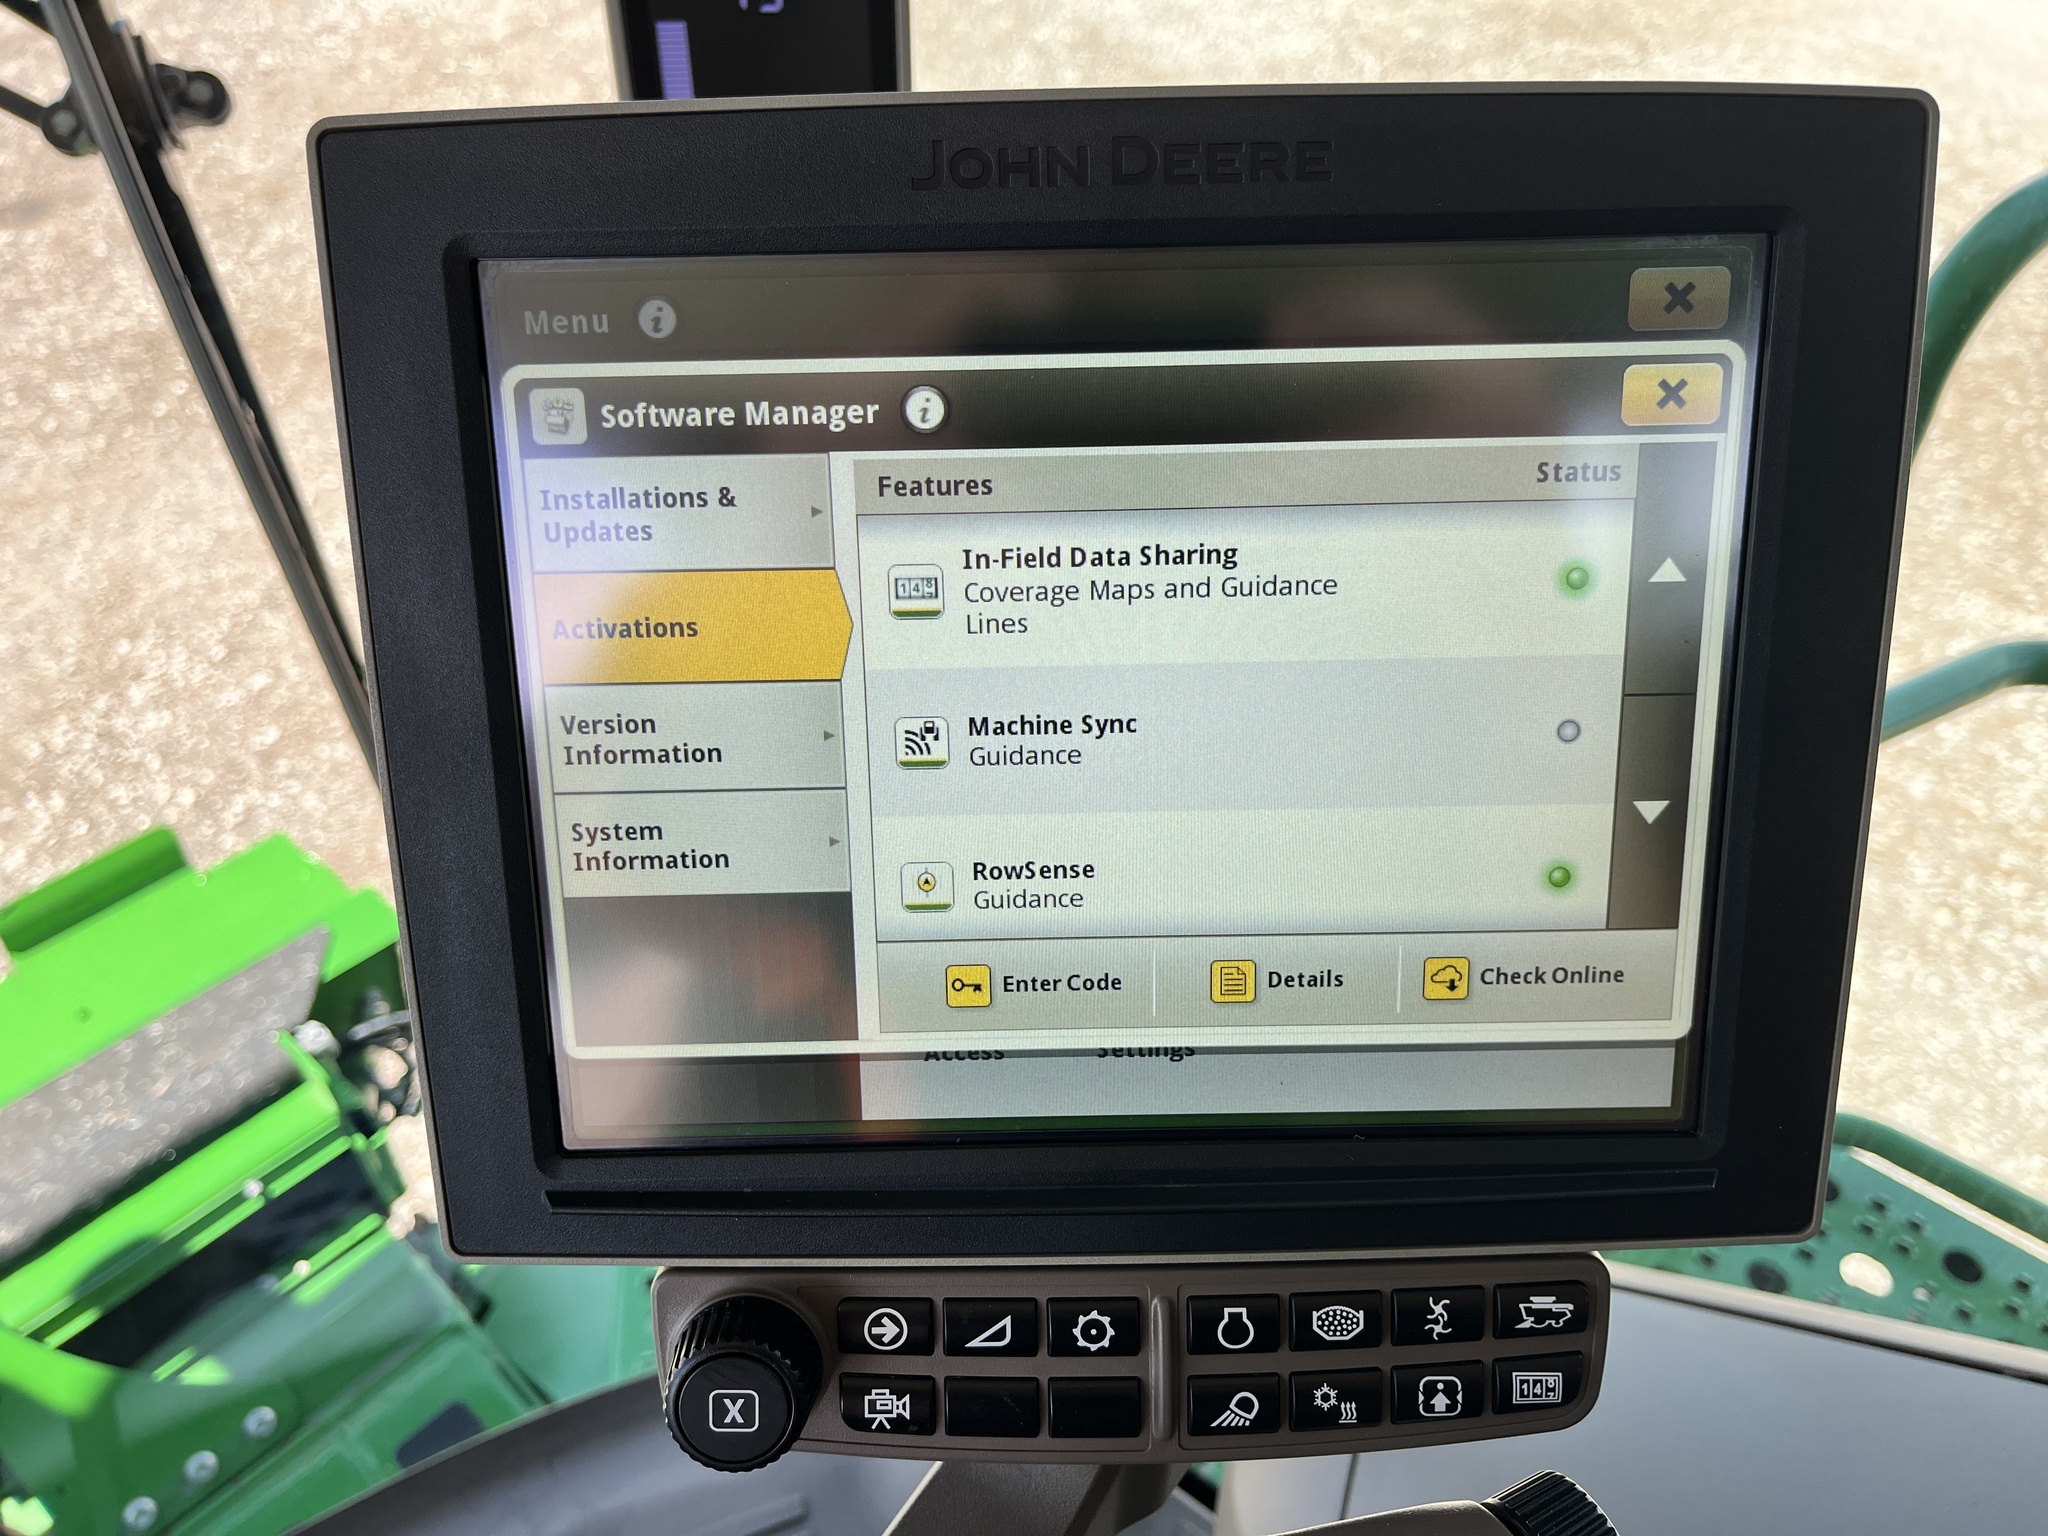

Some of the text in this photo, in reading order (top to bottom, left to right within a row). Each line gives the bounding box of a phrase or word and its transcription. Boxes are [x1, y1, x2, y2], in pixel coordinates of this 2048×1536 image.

[523, 309, 610, 336] Menu
[600, 400, 880, 432] Software Manager
[1537, 461, 1622, 483] Status
[877, 474, 994, 498] Features
[540, 486, 738, 512] Installations &
[544, 521, 654, 547] Updates
[962, 542, 1239, 572] In-Field Data Sharing
[963, 573, 1339, 608] Coverage Maps and Guidance
[552, 617, 699, 640] Activations
[966, 613, 1029, 635] Lines
[560, 713, 657, 735] Version
[967, 713, 1139, 741] Machine Sync
[563, 742, 723, 766] Information
[969, 744, 1083, 767] Guidance
[571, 821, 664, 847] System
[573, 849, 731, 872] Information
[972, 860, 1096, 881] RowSense
[973, 889, 1085, 910] Guidance
[1002, 971, 1122, 994] Enter Code
[1267, 968, 1344, 989] Details
[1480, 964, 1625, 987] Check Online
